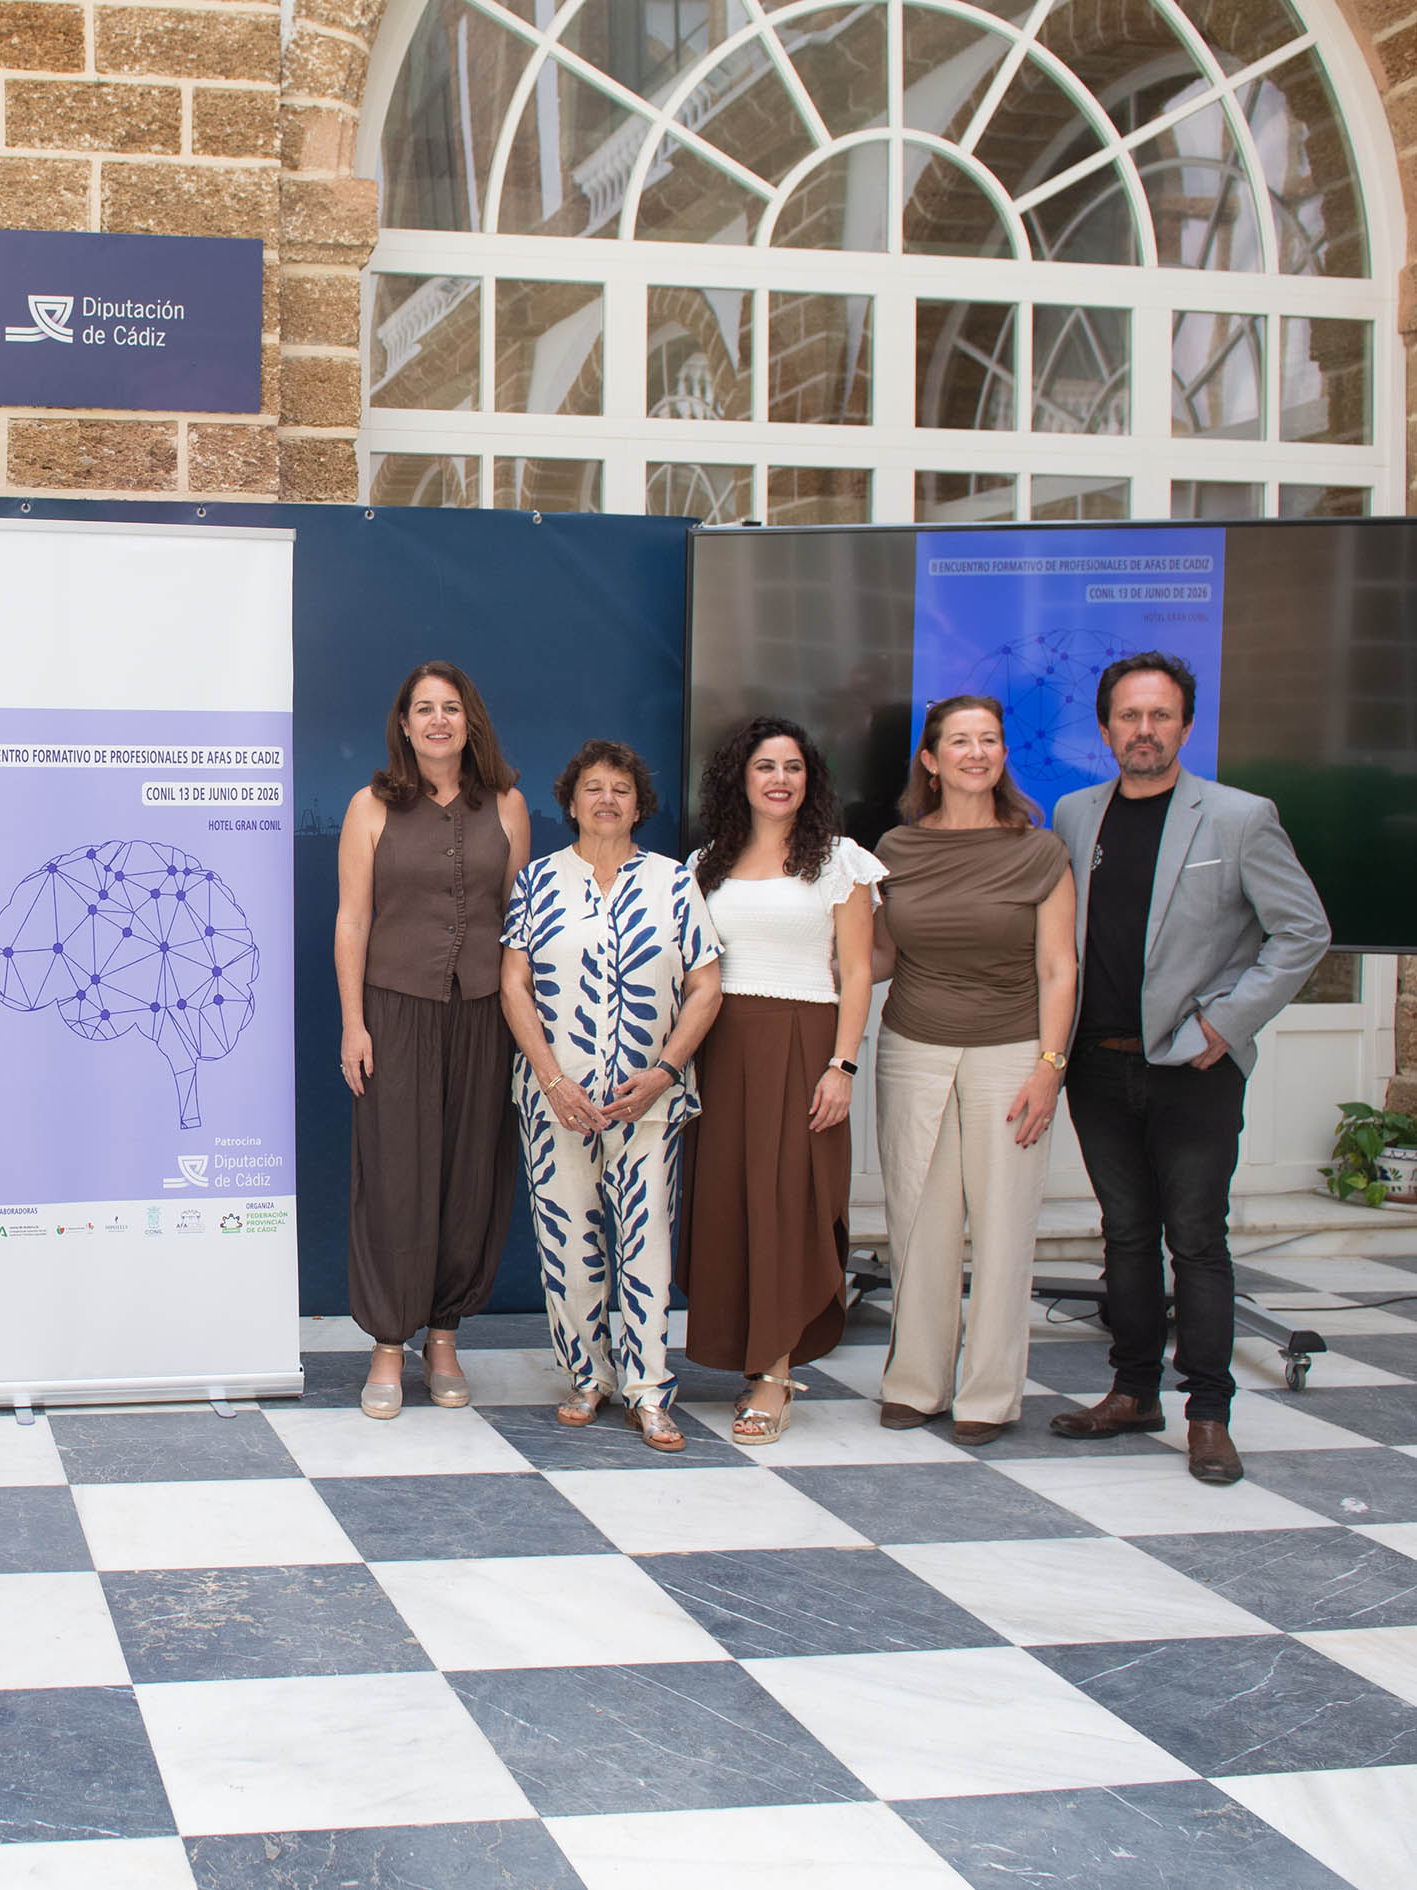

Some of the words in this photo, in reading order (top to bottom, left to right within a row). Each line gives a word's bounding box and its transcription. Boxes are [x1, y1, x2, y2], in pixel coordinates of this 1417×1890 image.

[83, 297, 185, 321] Diputación
[82, 325, 106, 345] de
[113, 325, 166, 347] Cádiz
[939, 560, 990, 573] ENCUENTRO
[992, 559, 1042, 573] FORMATIVO
[1045, 559, 1056, 572] DE
[1059, 559, 1128, 572] PROFESIONALES
[1129, 559, 1142, 571] DE
[1144, 558, 1166, 571] AFAS
[1169, 558, 1181, 571] DE
[1182, 558, 1210, 570] CADIZ
[1089, 587, 1116, 600] CONIL
[1118, 587, 1128, 600] 13
[1131, 587, 1142, 600] DE
[1144, 587, 1171, 600] JUNIO
[1173, 587, 1184, 599] DE
[1187, 586, 1208, 599] 2026
[32, 749, 91, 764] FORMATIVO
[94, 750, 107, 764] DE
[110, 750, 188, 764] PROFESIONALES
[191, 750, 204, 764] DE
[206, 751, 232, 764] AFAS
[235, 751, 248, 765] DE
[251, 751, 280, 765] CADIZ
[146, 787, 176, 801] CONIL
[179, 787, 190, 801] 13
[193, 787, 205, 801] DE
[208, 787, 238, 801] JUNIO
[241, 788, 254, 801] DE
[257, 787, 280, 801] 2026
[208, 820, 233, 831] HOTEL
[235, 820, 257, 831] GRAN
[259, 820, 282, 831] CONIL
[214, 1136, 262, 1146] Patrocina
[214, 1154, 283, 1170] Diputación
[214, 1174, 231, 1188] de
[235, 1172, 271, 1188] Cádiz
[245, 1201, 275, 1210] ORGANIZA
[246, 1211, 288, 1219] FEDERACIÓN
[246, 1218, 286, 1226] PROVINCIAL
